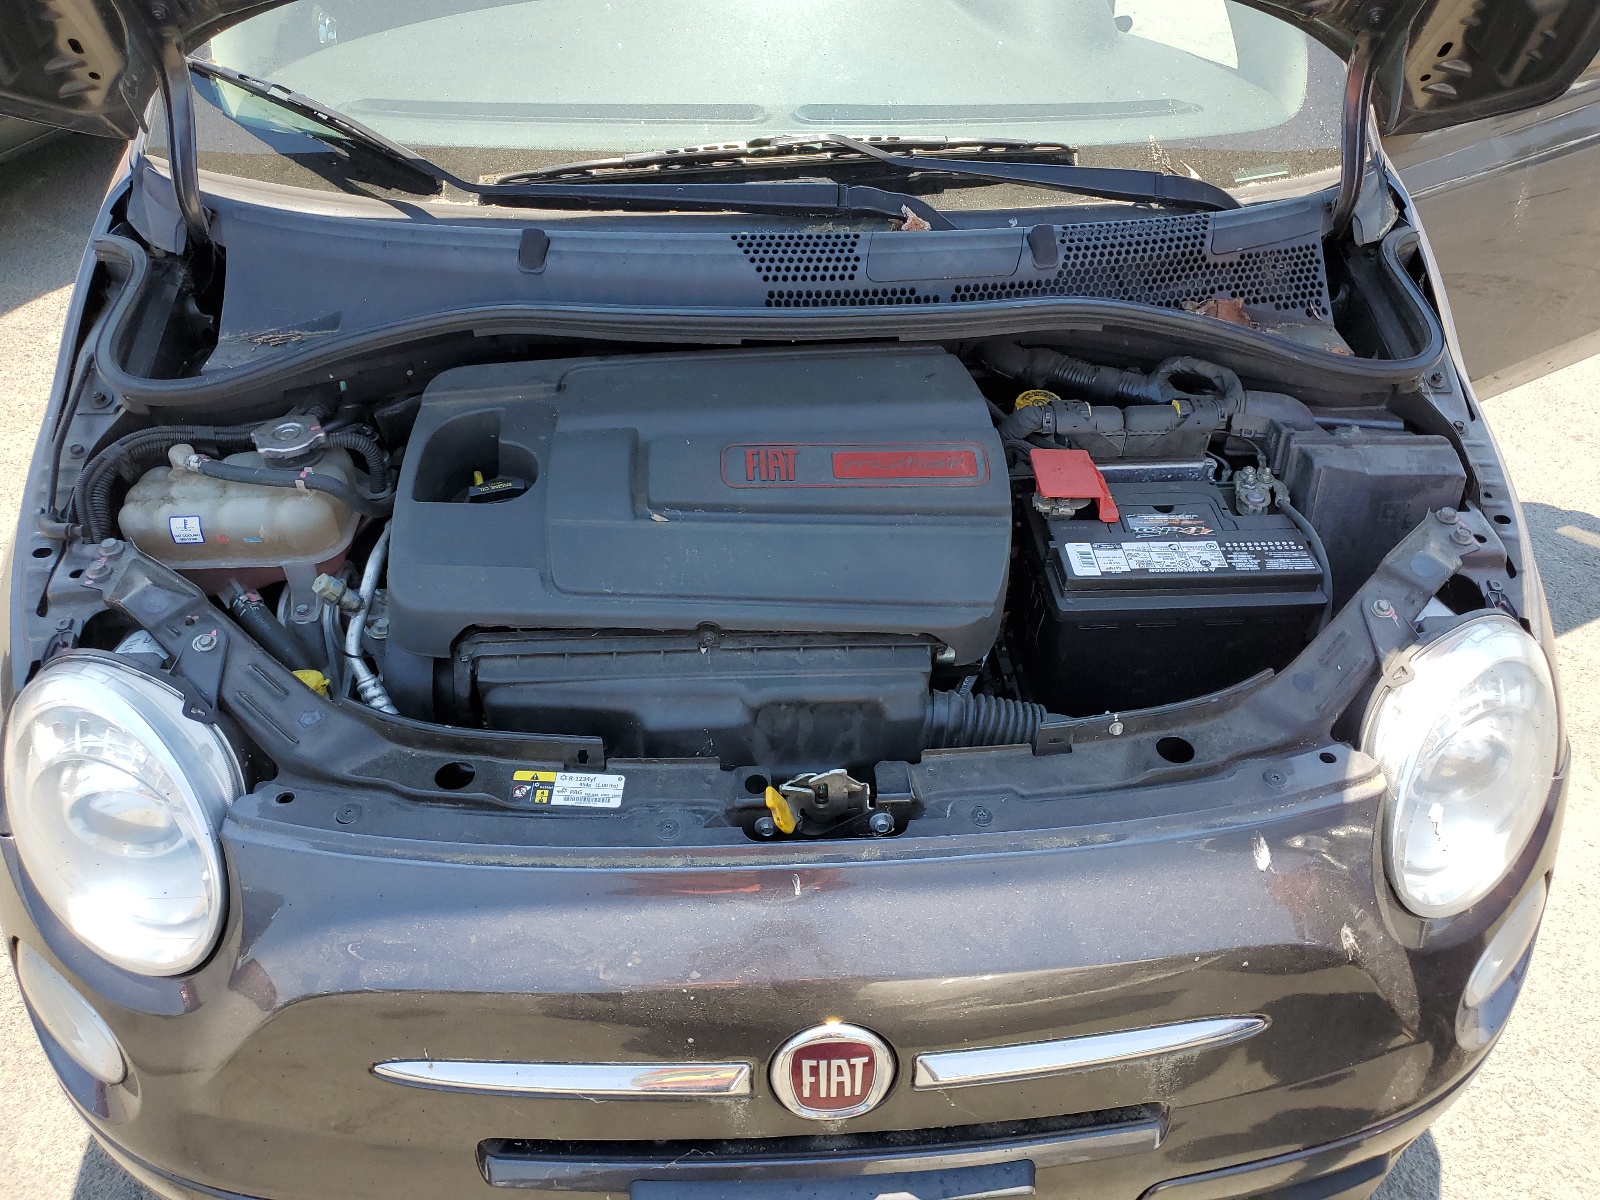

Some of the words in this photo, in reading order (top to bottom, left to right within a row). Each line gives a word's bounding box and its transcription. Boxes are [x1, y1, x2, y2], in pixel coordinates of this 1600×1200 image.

[745, 449, 798, 481] FIAT
[843, 456, 967, 472] multiair
[801, 1057, 869, 1098] FIAT
